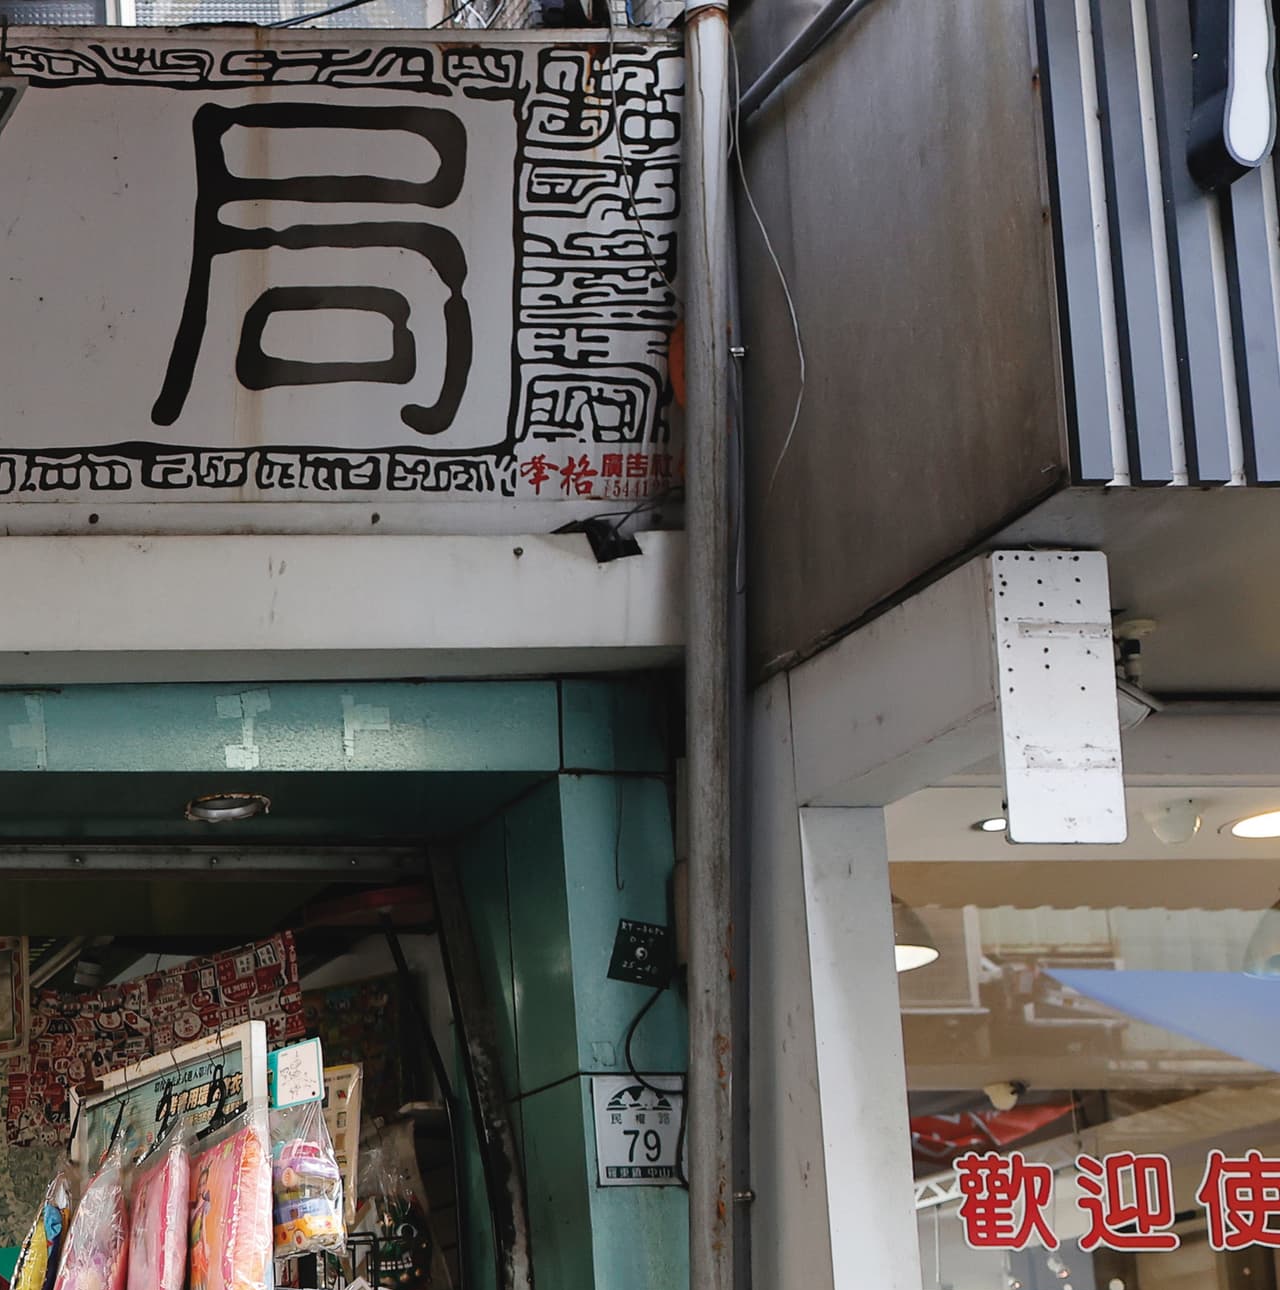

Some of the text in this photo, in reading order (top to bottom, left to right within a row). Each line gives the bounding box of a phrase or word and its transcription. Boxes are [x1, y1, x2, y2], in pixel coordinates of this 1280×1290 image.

[623, 1129, 662, 1163] 79
[953, 1150, 1280, 1251] 歡迎使
